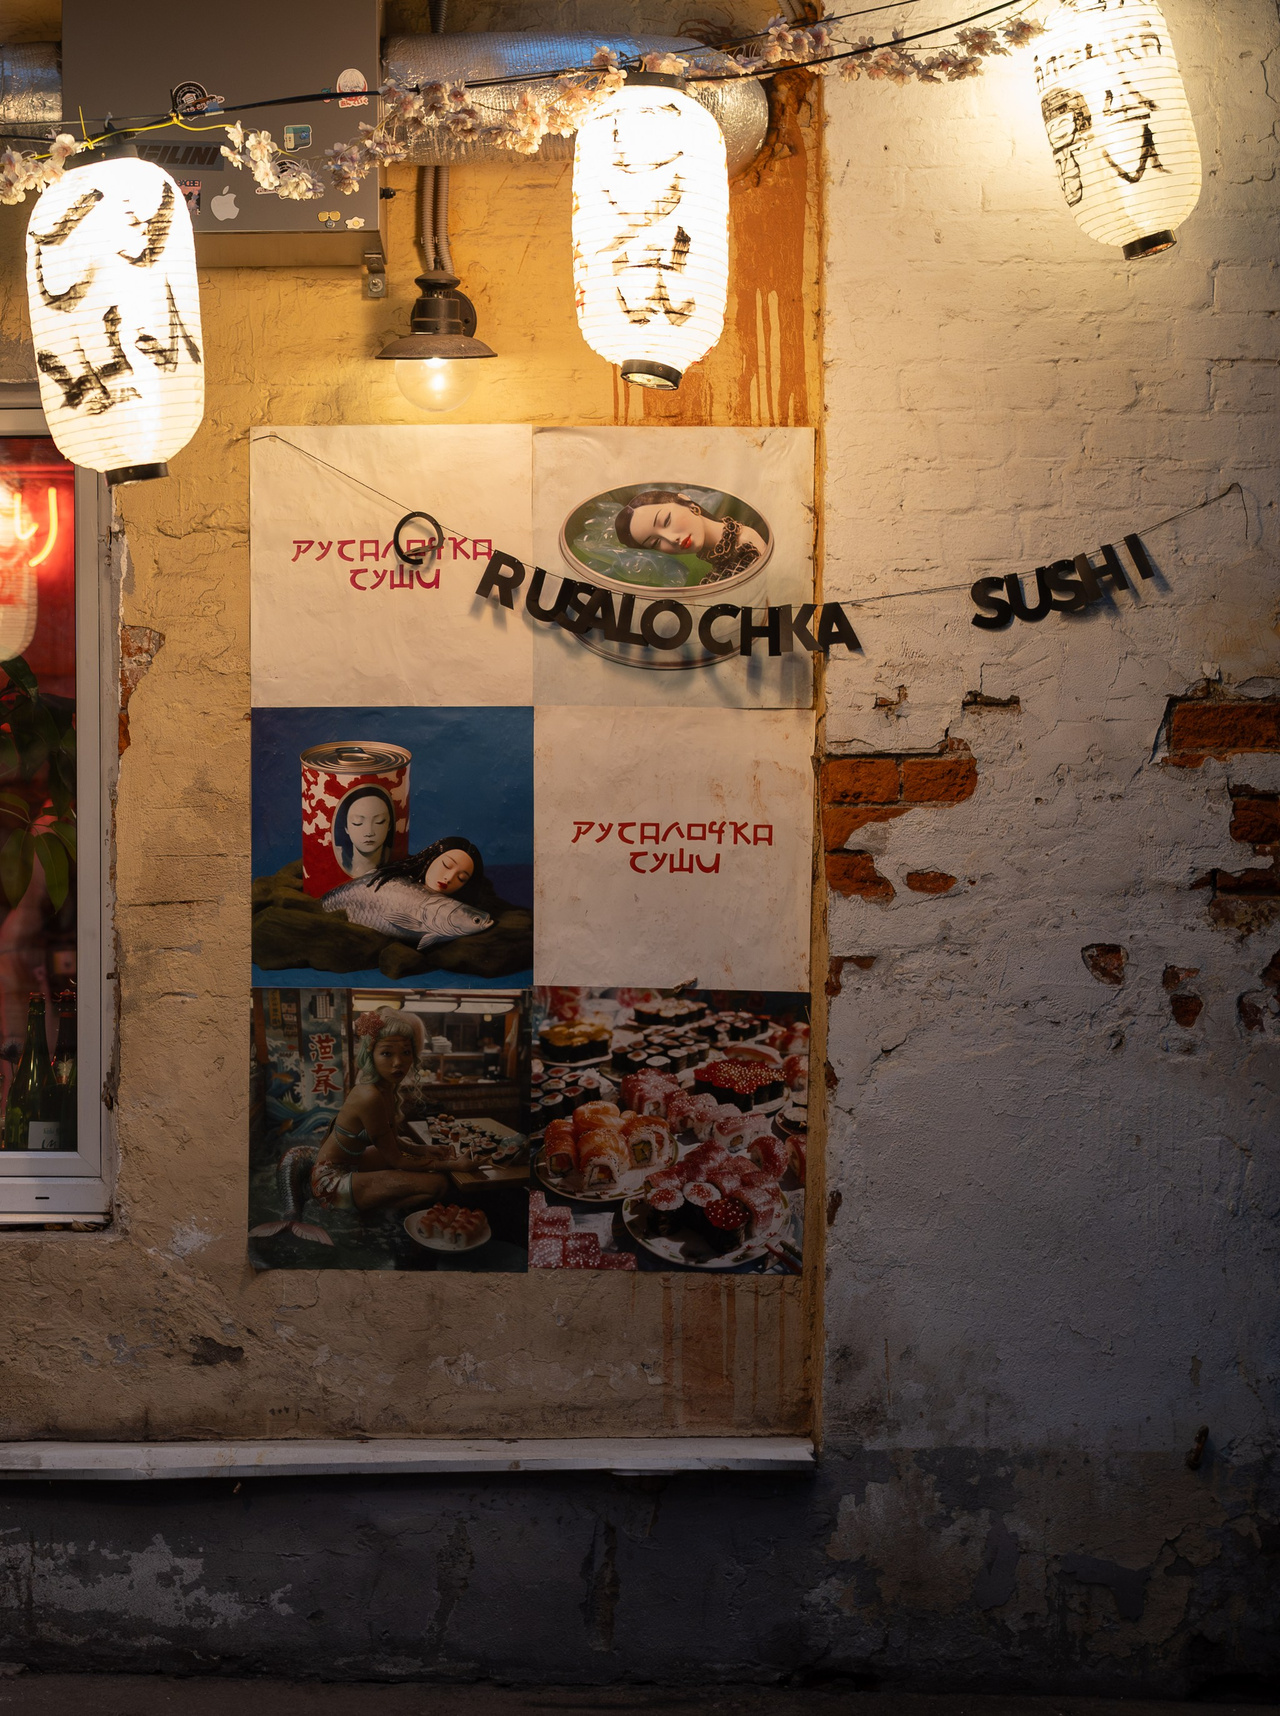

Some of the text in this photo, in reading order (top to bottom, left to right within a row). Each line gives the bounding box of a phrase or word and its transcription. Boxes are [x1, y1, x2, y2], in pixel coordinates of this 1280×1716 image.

[349, 564, 441, 591] СУШИ
[475, 533, 1154, 656] RUSALOCHKA SUSHI
[571, 820, 773, 846] РУСАЛОЧКА
[629, 848, 721, 874] СУШИ
